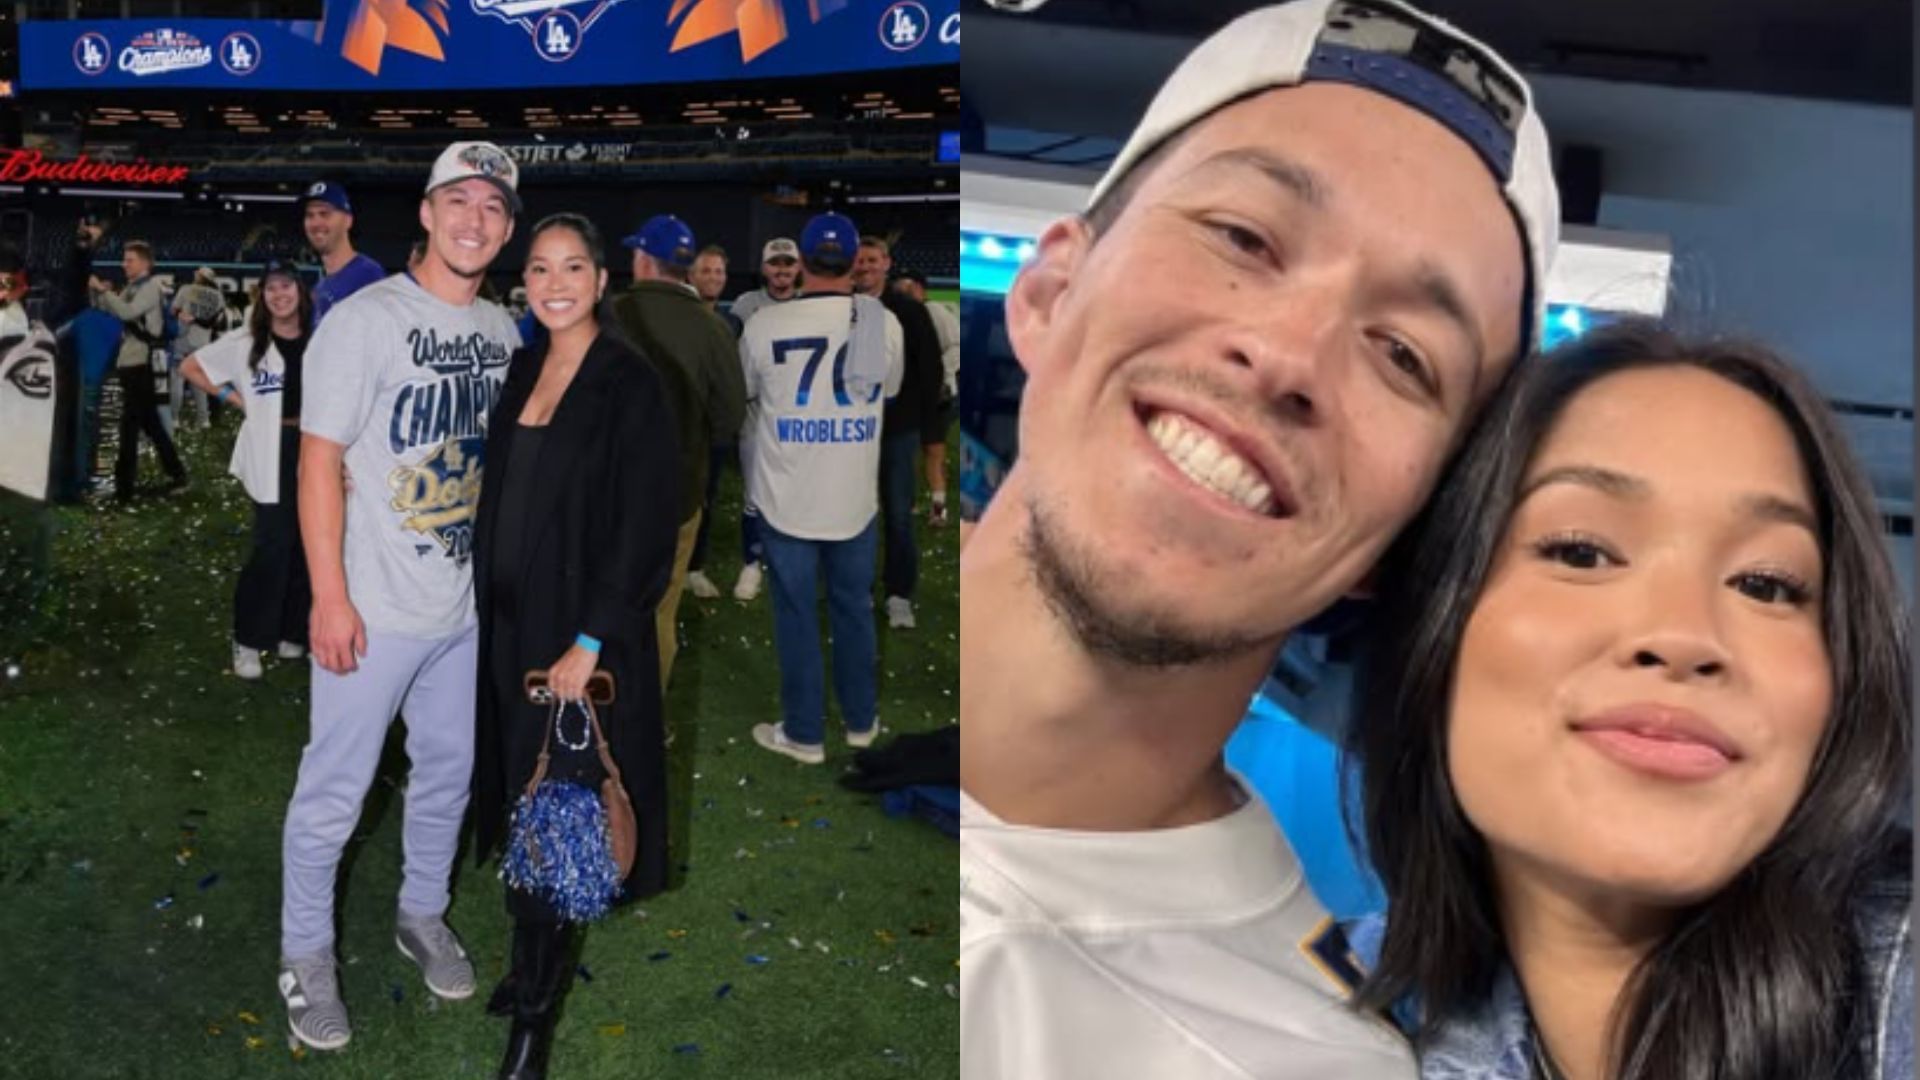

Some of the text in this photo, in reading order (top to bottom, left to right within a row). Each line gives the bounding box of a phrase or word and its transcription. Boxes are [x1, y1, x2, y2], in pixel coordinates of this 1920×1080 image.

[546, 16, 571, 53] LA
[83, 37, 102, 67] LA
[119, 45, 212, 76] Champions
[231, 37, 251, 67] LA
[0, 148, 188, 182] Budweiser
[407, 328, 472, 367] World
